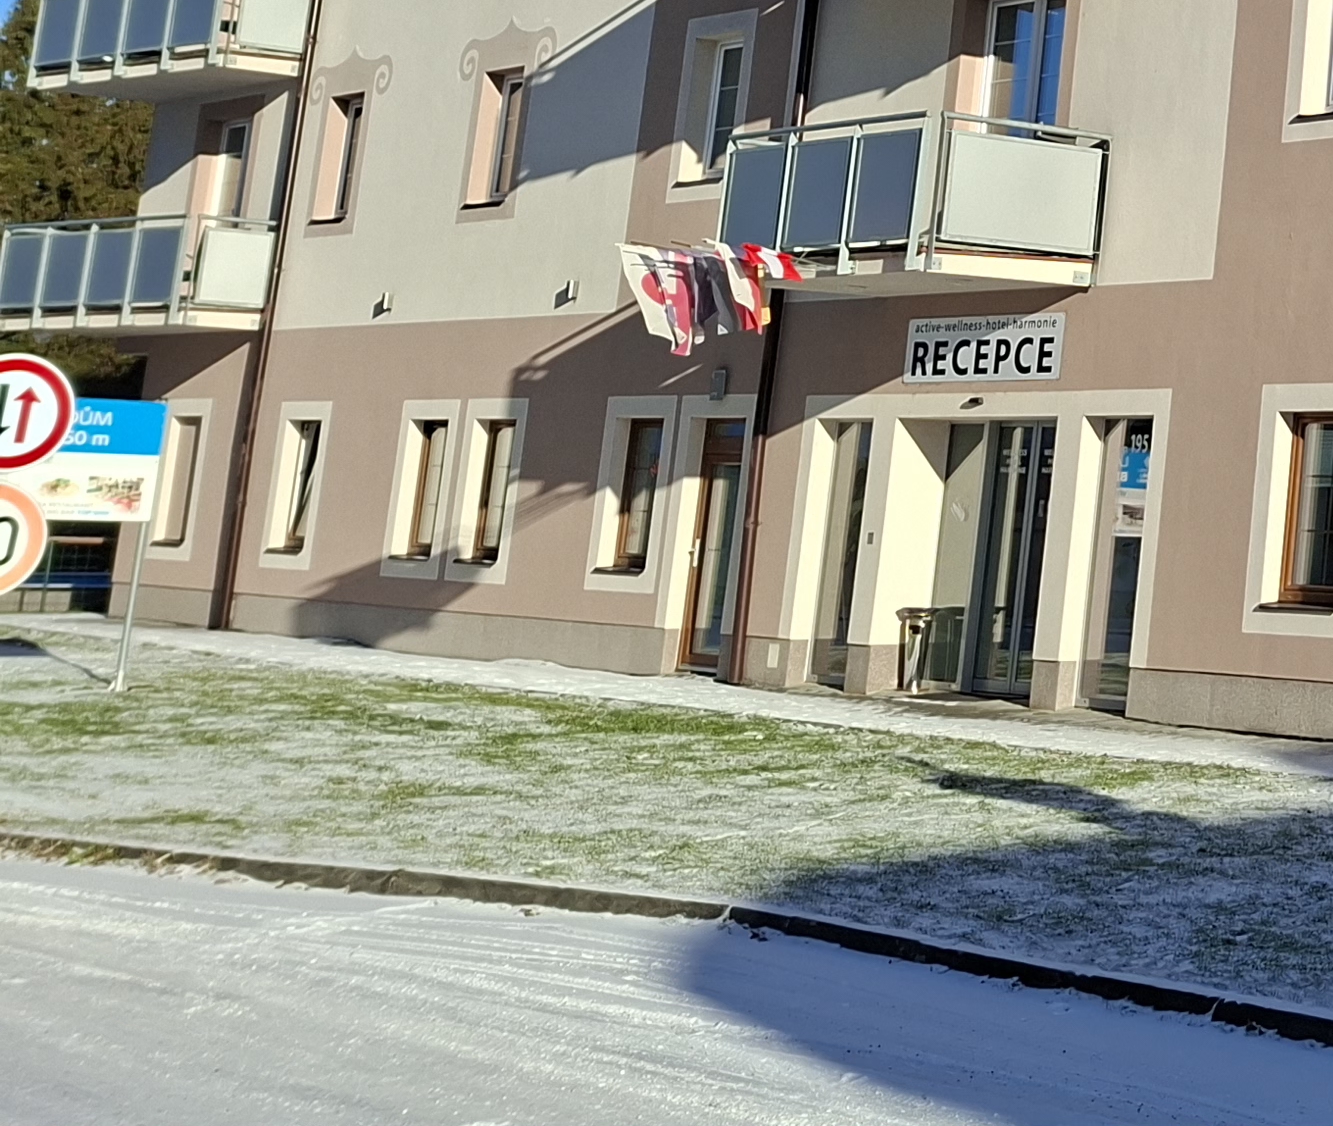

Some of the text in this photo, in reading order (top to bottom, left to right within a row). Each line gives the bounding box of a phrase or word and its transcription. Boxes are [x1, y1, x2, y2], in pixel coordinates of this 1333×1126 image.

[910, 337, 1055, 377] RECEPCE
[91, 434, 110, 447] m
[1130, 434, 1150, 453] 195
